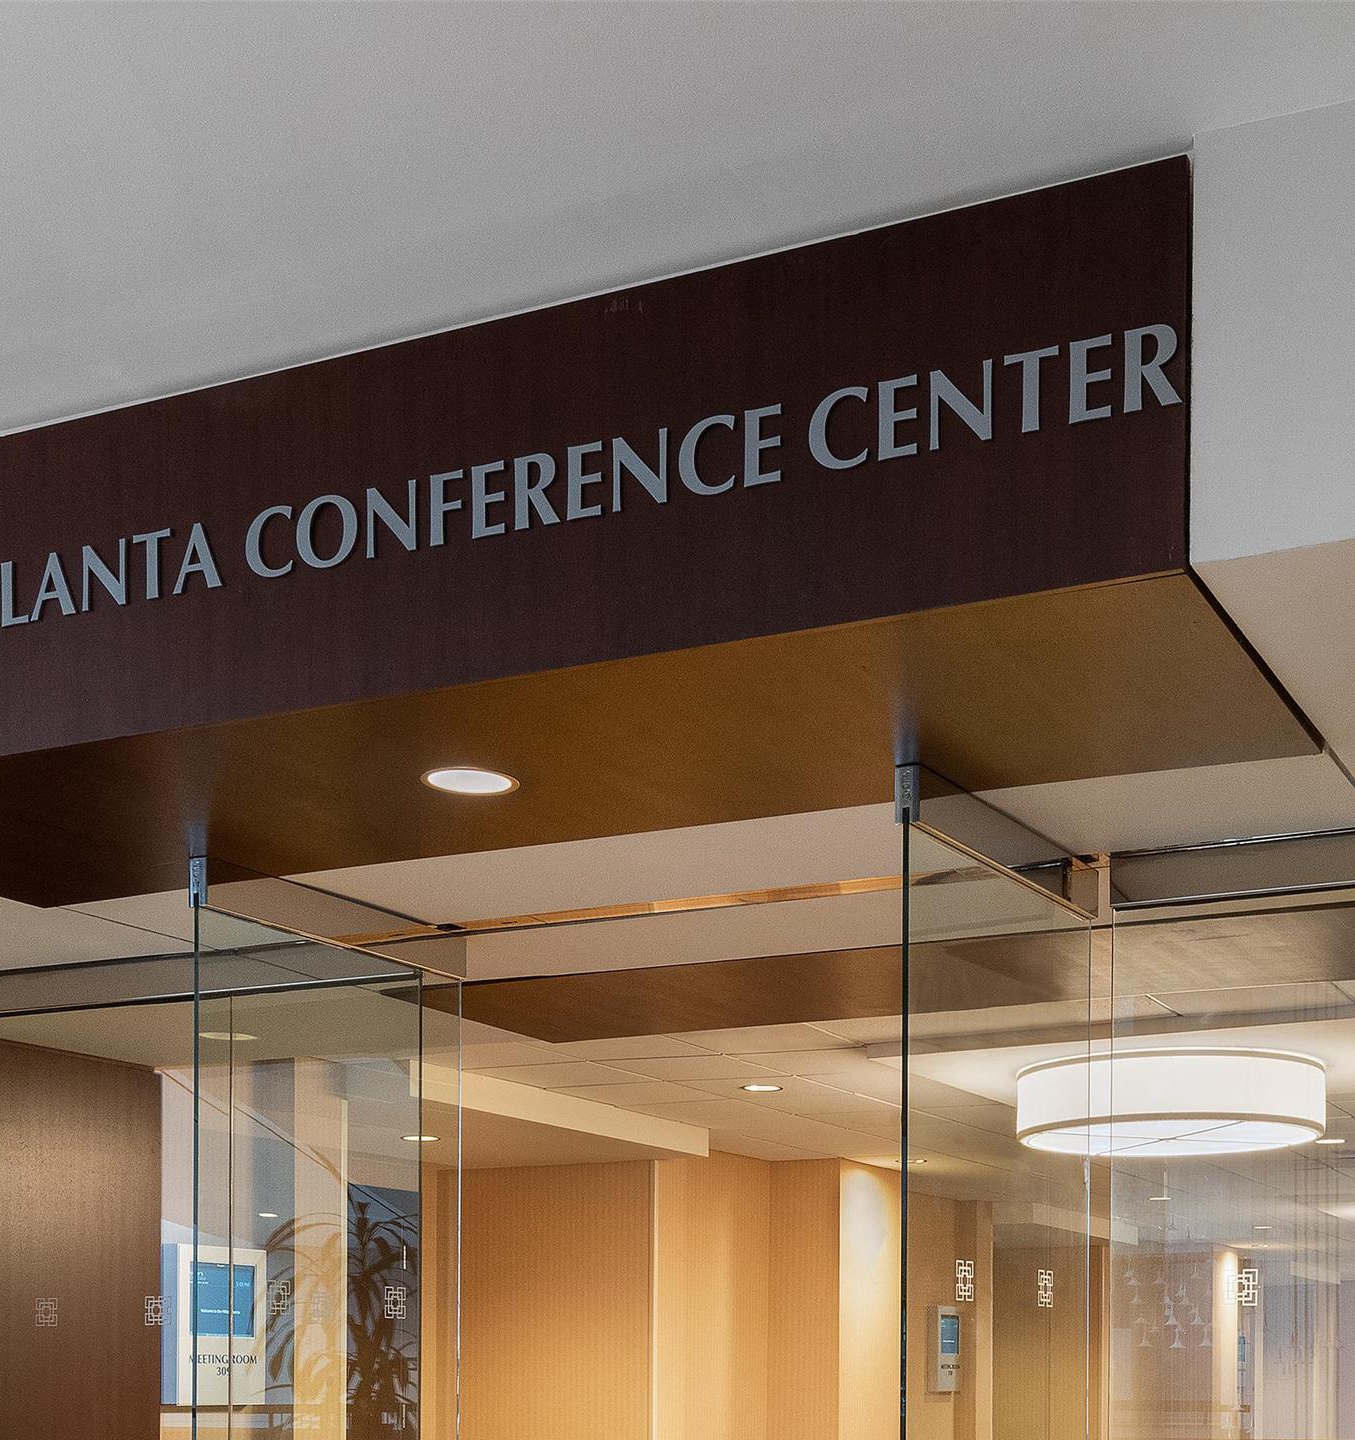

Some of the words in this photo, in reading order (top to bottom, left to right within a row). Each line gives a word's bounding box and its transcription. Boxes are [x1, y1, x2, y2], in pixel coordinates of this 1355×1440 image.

[244, 403, 782, 578] CONFERENCE
[808, 323, 1184, 471] CENTER
[231, 1354, 257, 1364] ROOM
